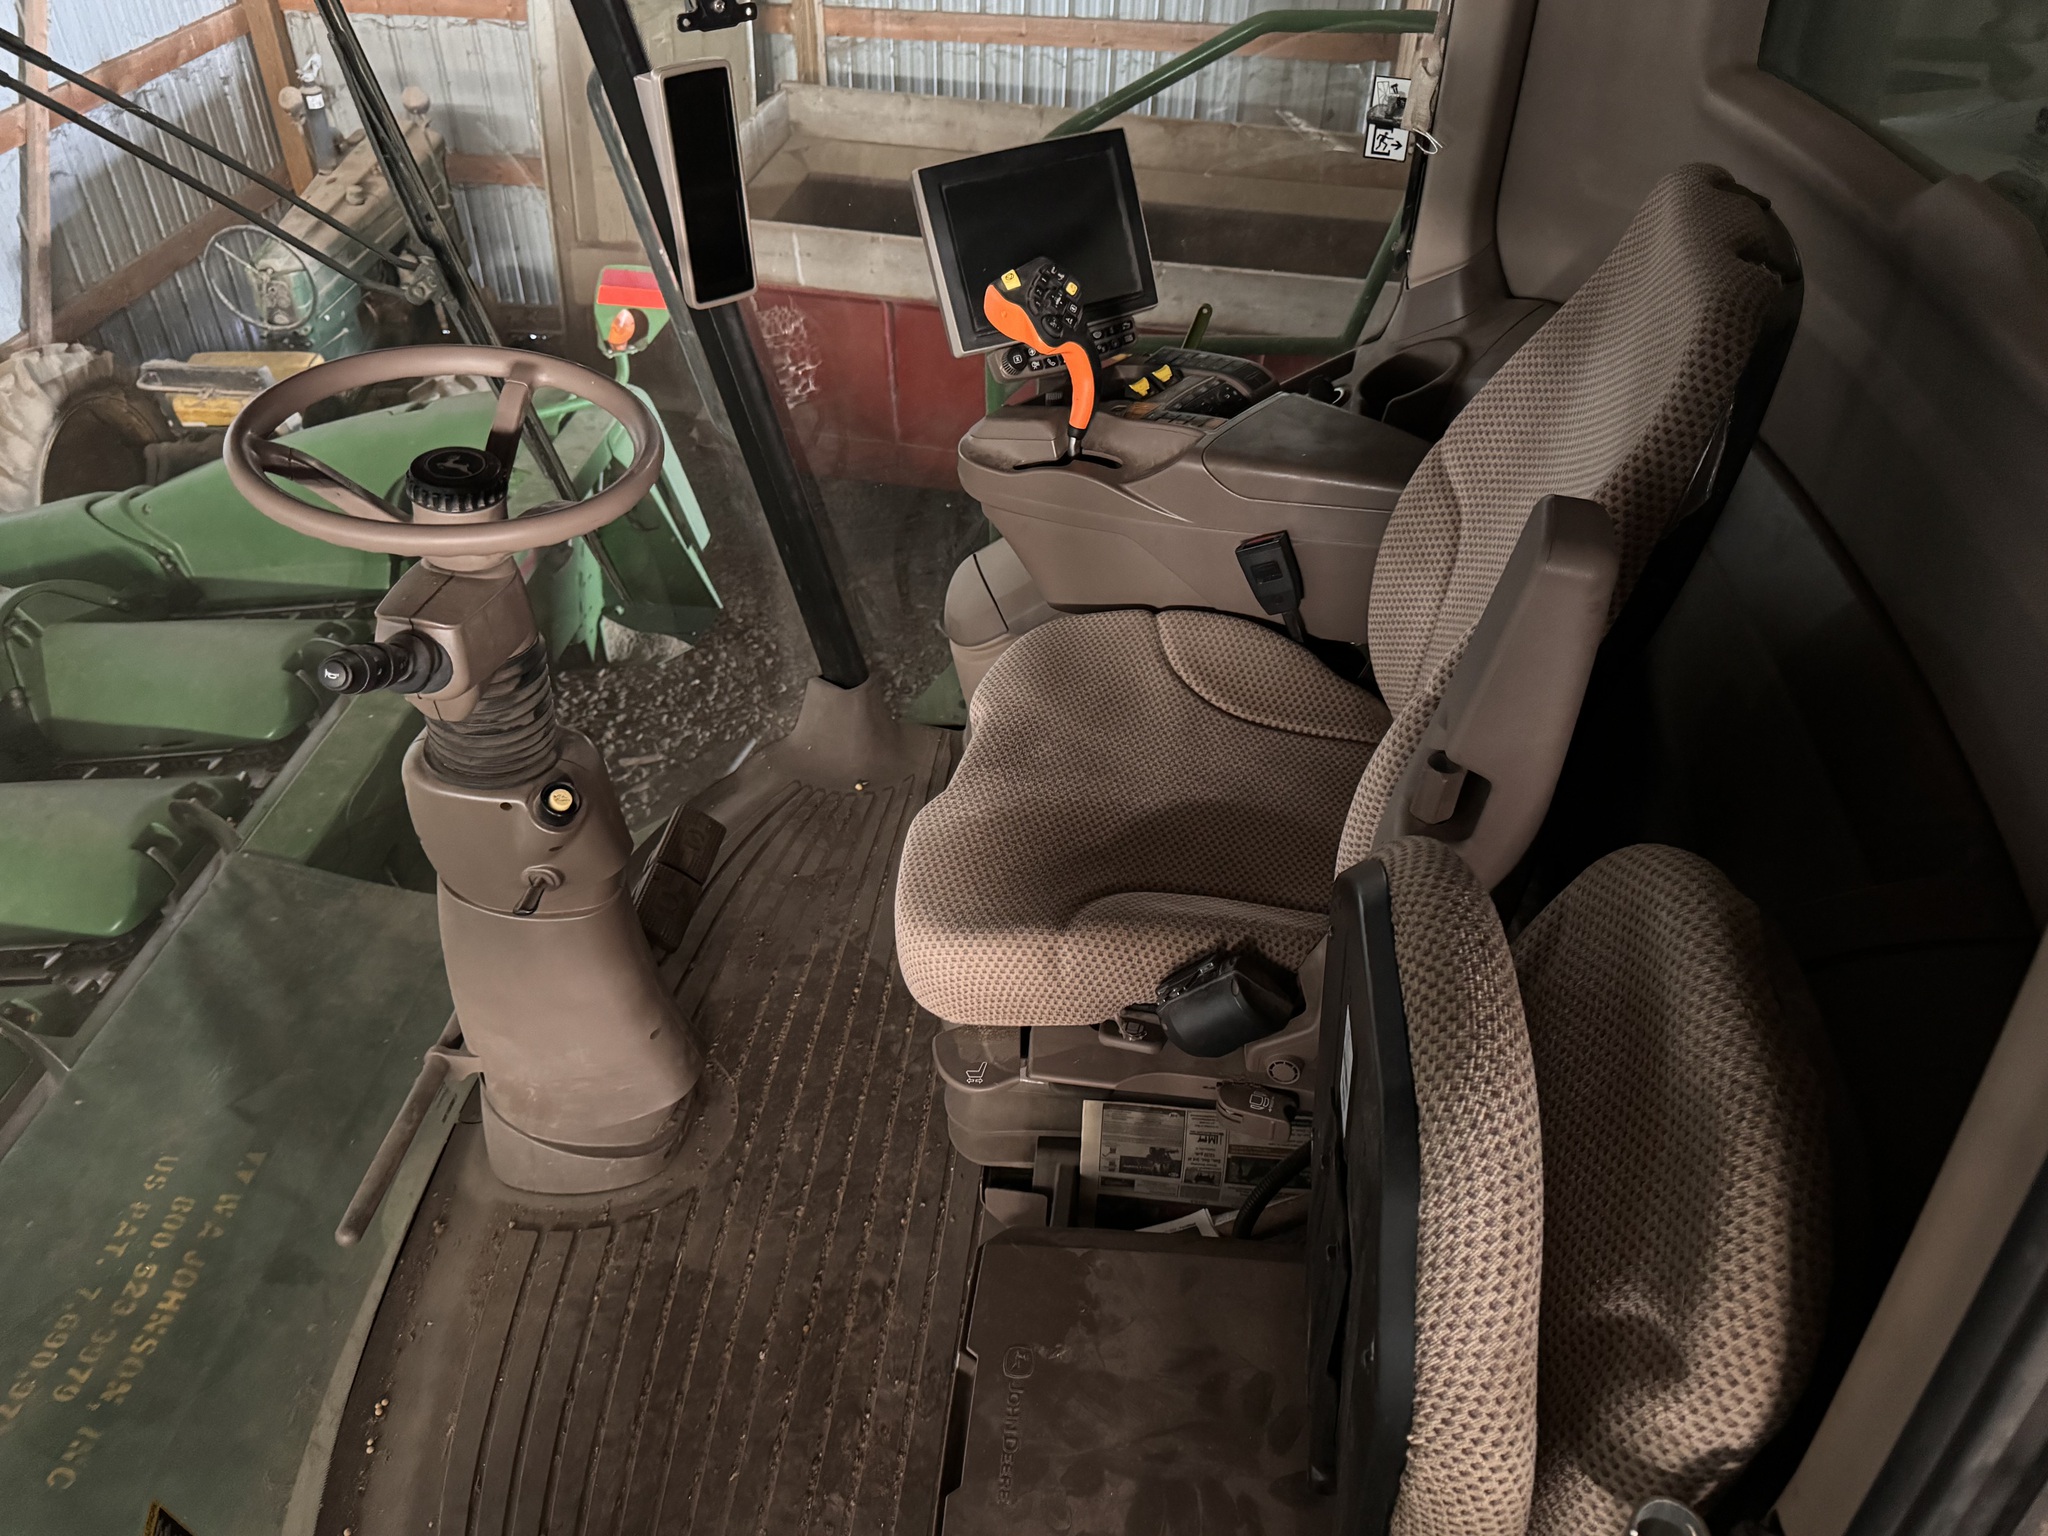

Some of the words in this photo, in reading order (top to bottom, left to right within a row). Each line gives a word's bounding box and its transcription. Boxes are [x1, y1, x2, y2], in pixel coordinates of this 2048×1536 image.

[143, 1156, 179, 1190] US
[1004, 1381, 1024, 1434] JOHN
[997, 1435, 1018, 1504] DEERE
